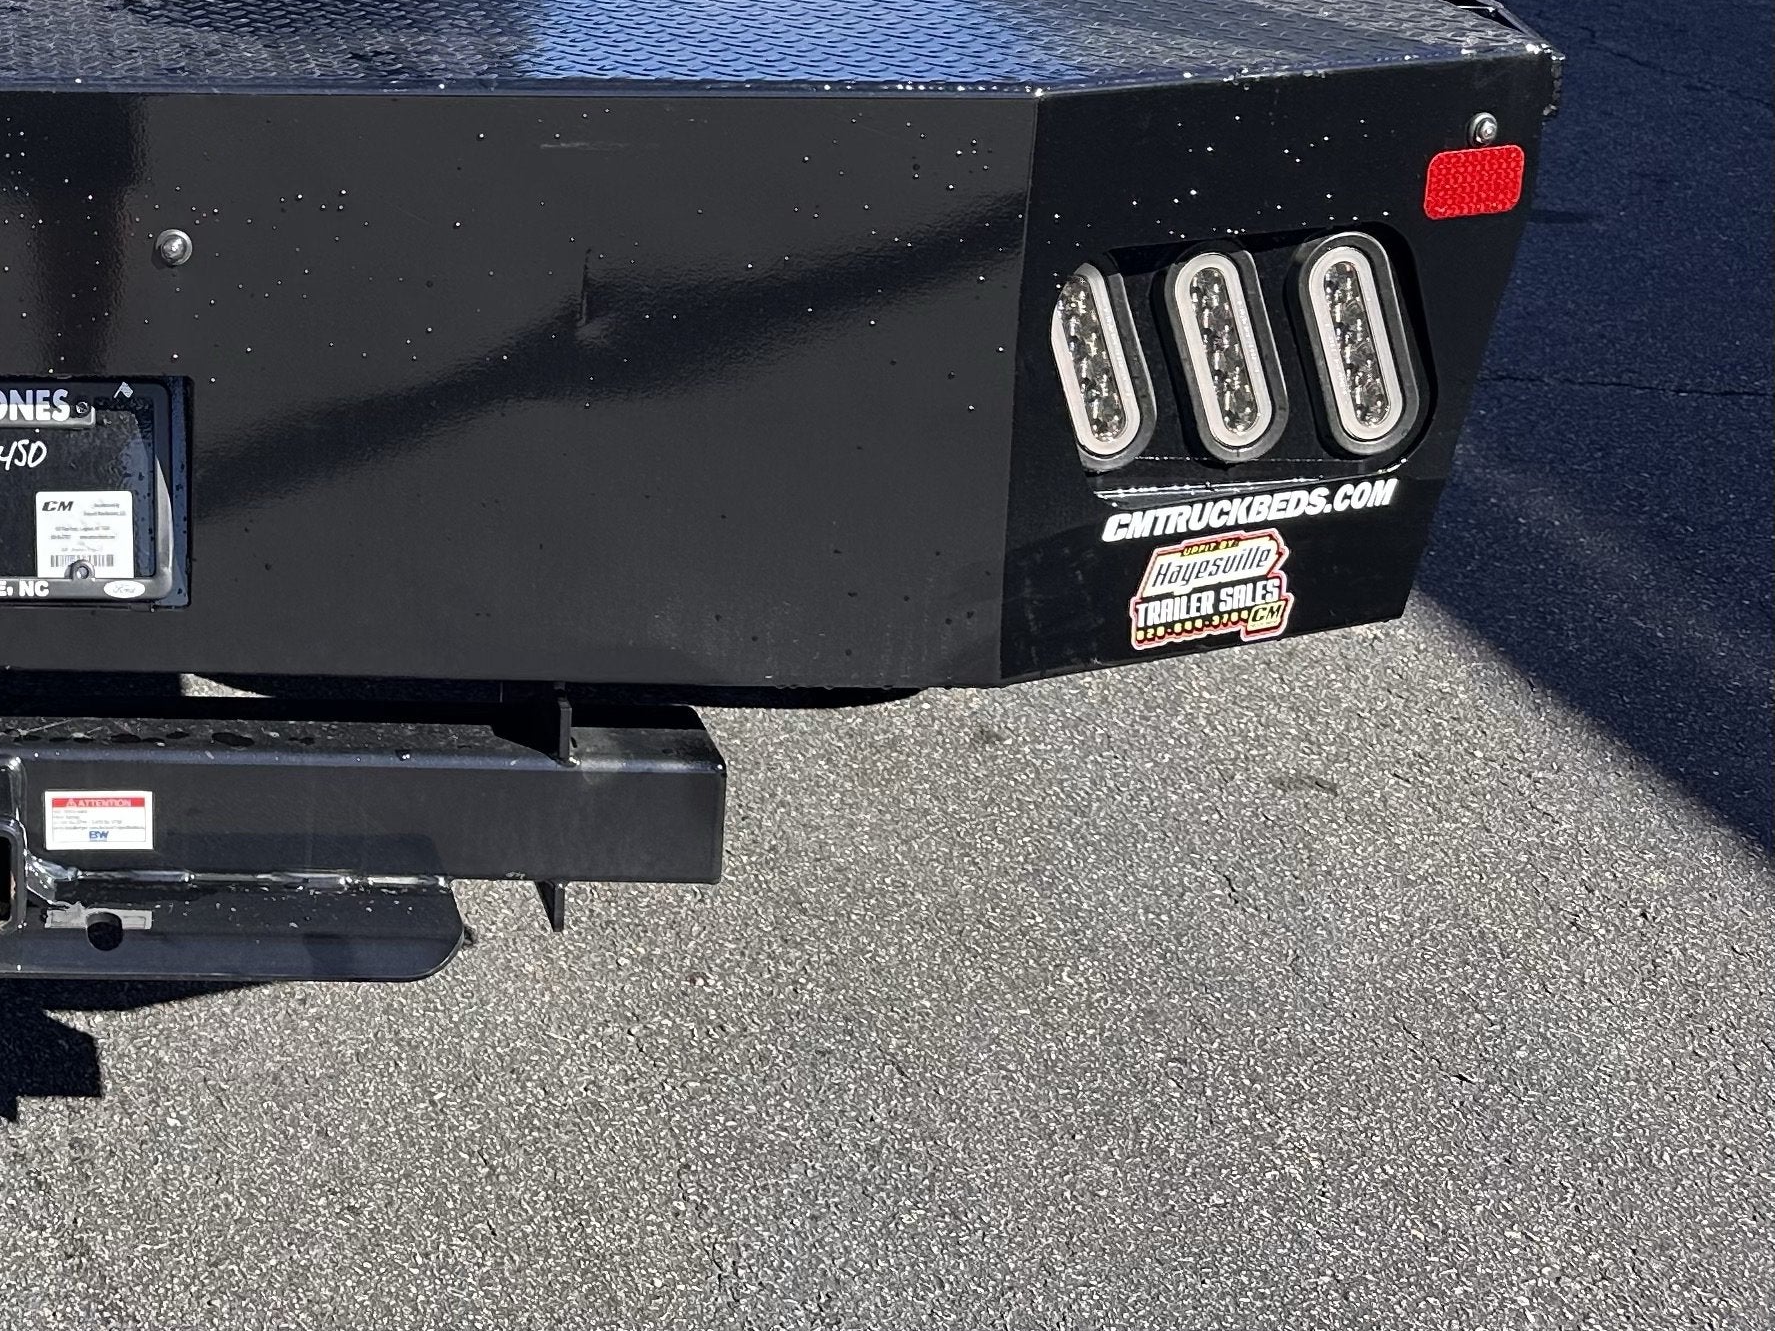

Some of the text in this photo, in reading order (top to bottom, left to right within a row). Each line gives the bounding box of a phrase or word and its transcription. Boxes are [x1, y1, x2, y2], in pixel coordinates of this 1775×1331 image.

[42, 500, 74, 511] CM
[1102, 478, 1399, 542] CMTRUCKBEDS.COM
[1152, 546, 1271, 586] Hayesville
[19, 580, 50, 597] NC
[1136, 578, 1280, 628] TRAILER SALES
[1252, 603, 1284, 622] CM
[78, 798, 132, 807] ATTENTION
